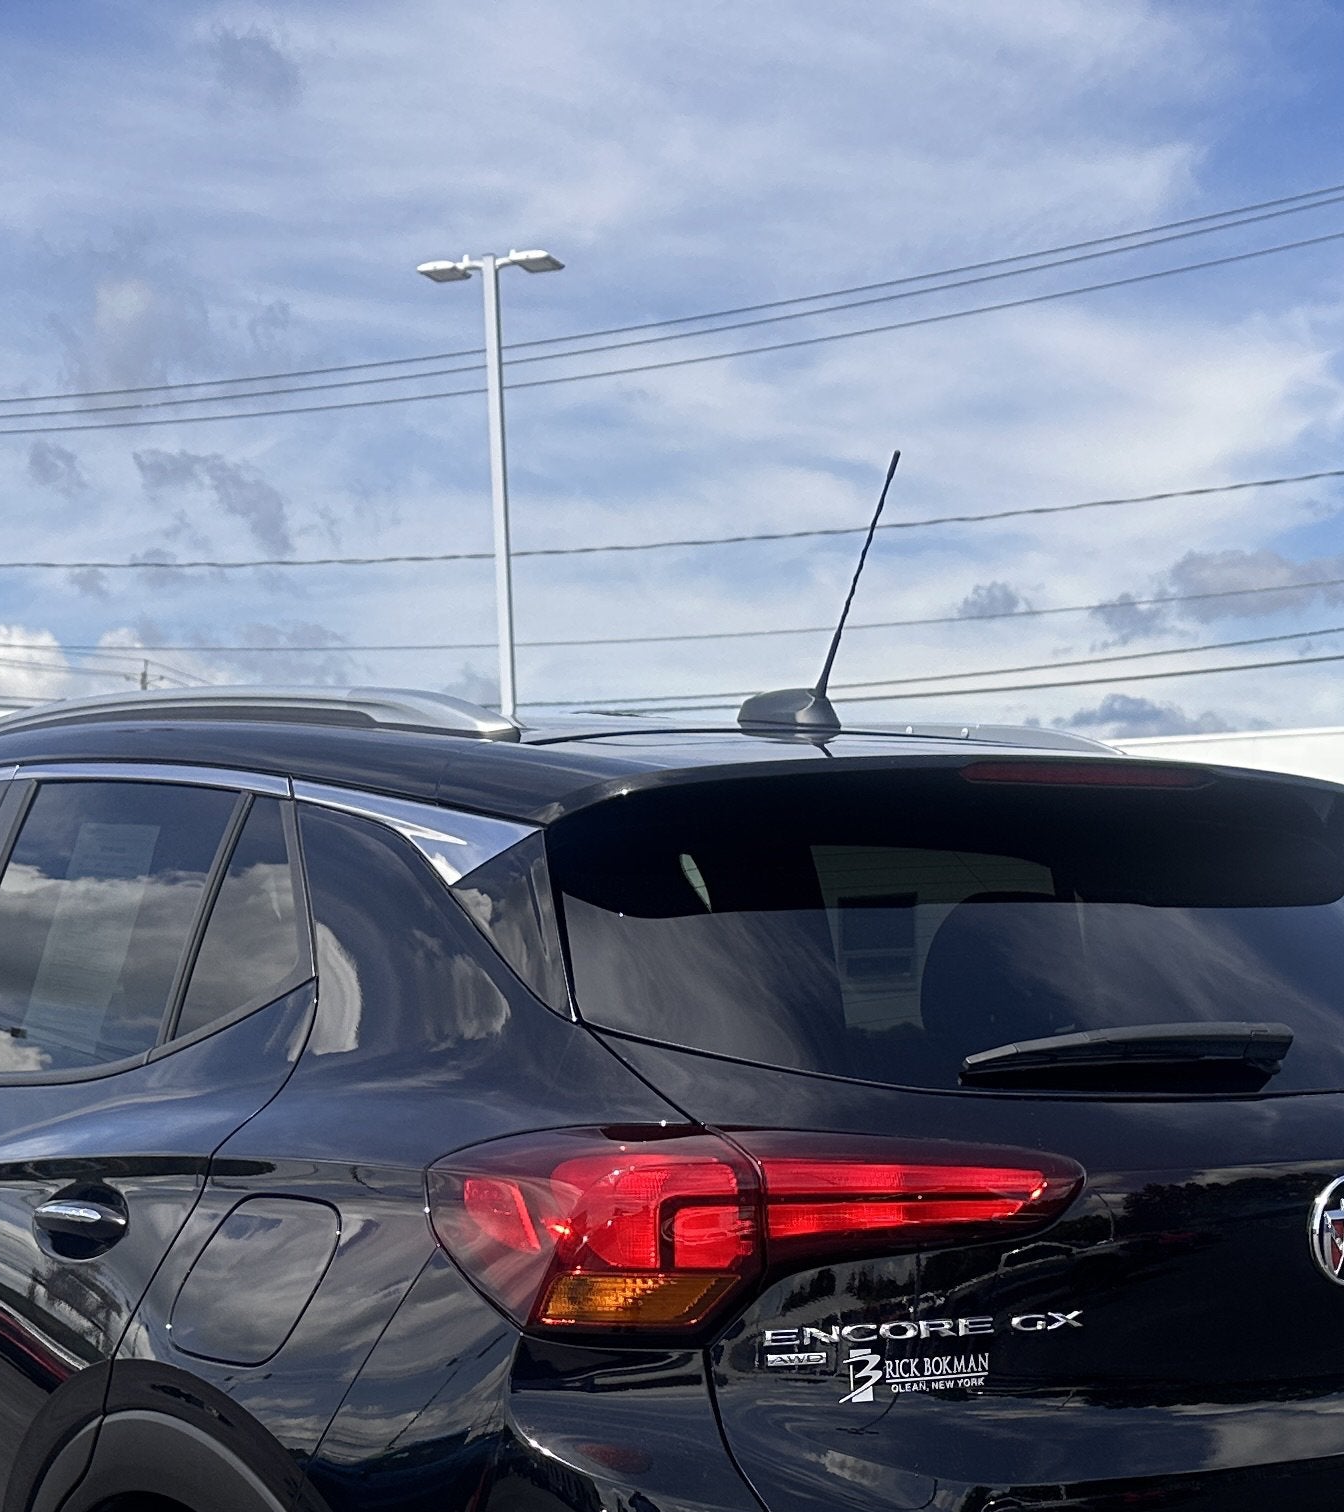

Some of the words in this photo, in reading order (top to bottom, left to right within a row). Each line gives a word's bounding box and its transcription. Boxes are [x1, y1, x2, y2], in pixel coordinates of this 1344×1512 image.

[763, 1316, 995, 1346] ENCORE
[1010, 1310, 1084, 1331] GX
[769, 1354, 825, 1366] AWD
[885, 1357, 920, 1379] RICK
[923, 1353, 990, 1376] BOKMAN
[891, 1382, 930, 1393] OLEAN,
[931, 1380, 955, 1391] NEW
[957, 1377, 985, 1387] YORK
